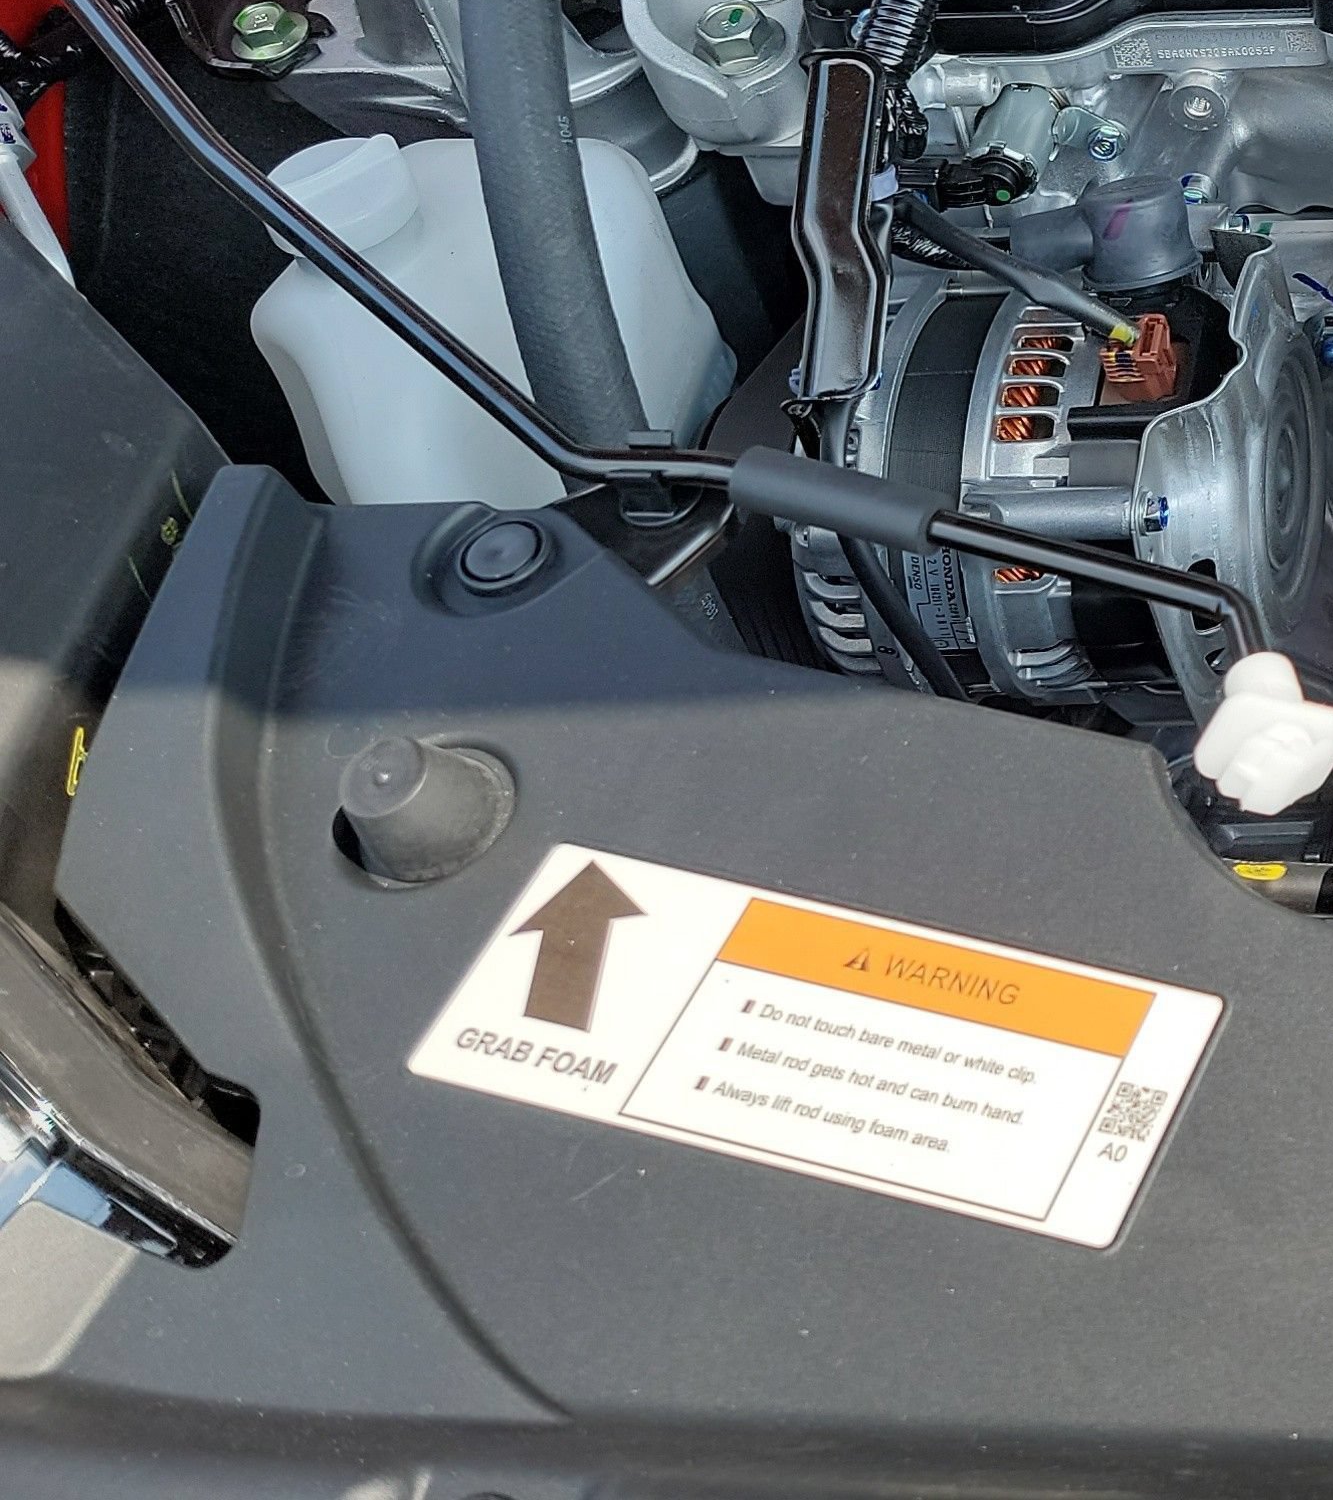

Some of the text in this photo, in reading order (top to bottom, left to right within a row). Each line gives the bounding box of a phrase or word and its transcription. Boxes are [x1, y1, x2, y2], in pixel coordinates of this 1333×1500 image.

[910, 556, 923, 591] DENSO
[884, 955, 1020, 1004] WARNING
[456, 1029, 617, 1084] GRAB FOAM
[759, 1003, 1037, 1085] Do not touch bare metal or white clip.
[736, 1041, 1024, 1125] Metal rod gets hot and can burn hand.
[712, 1081, 951, 1153] Always lift rod using foam area.
